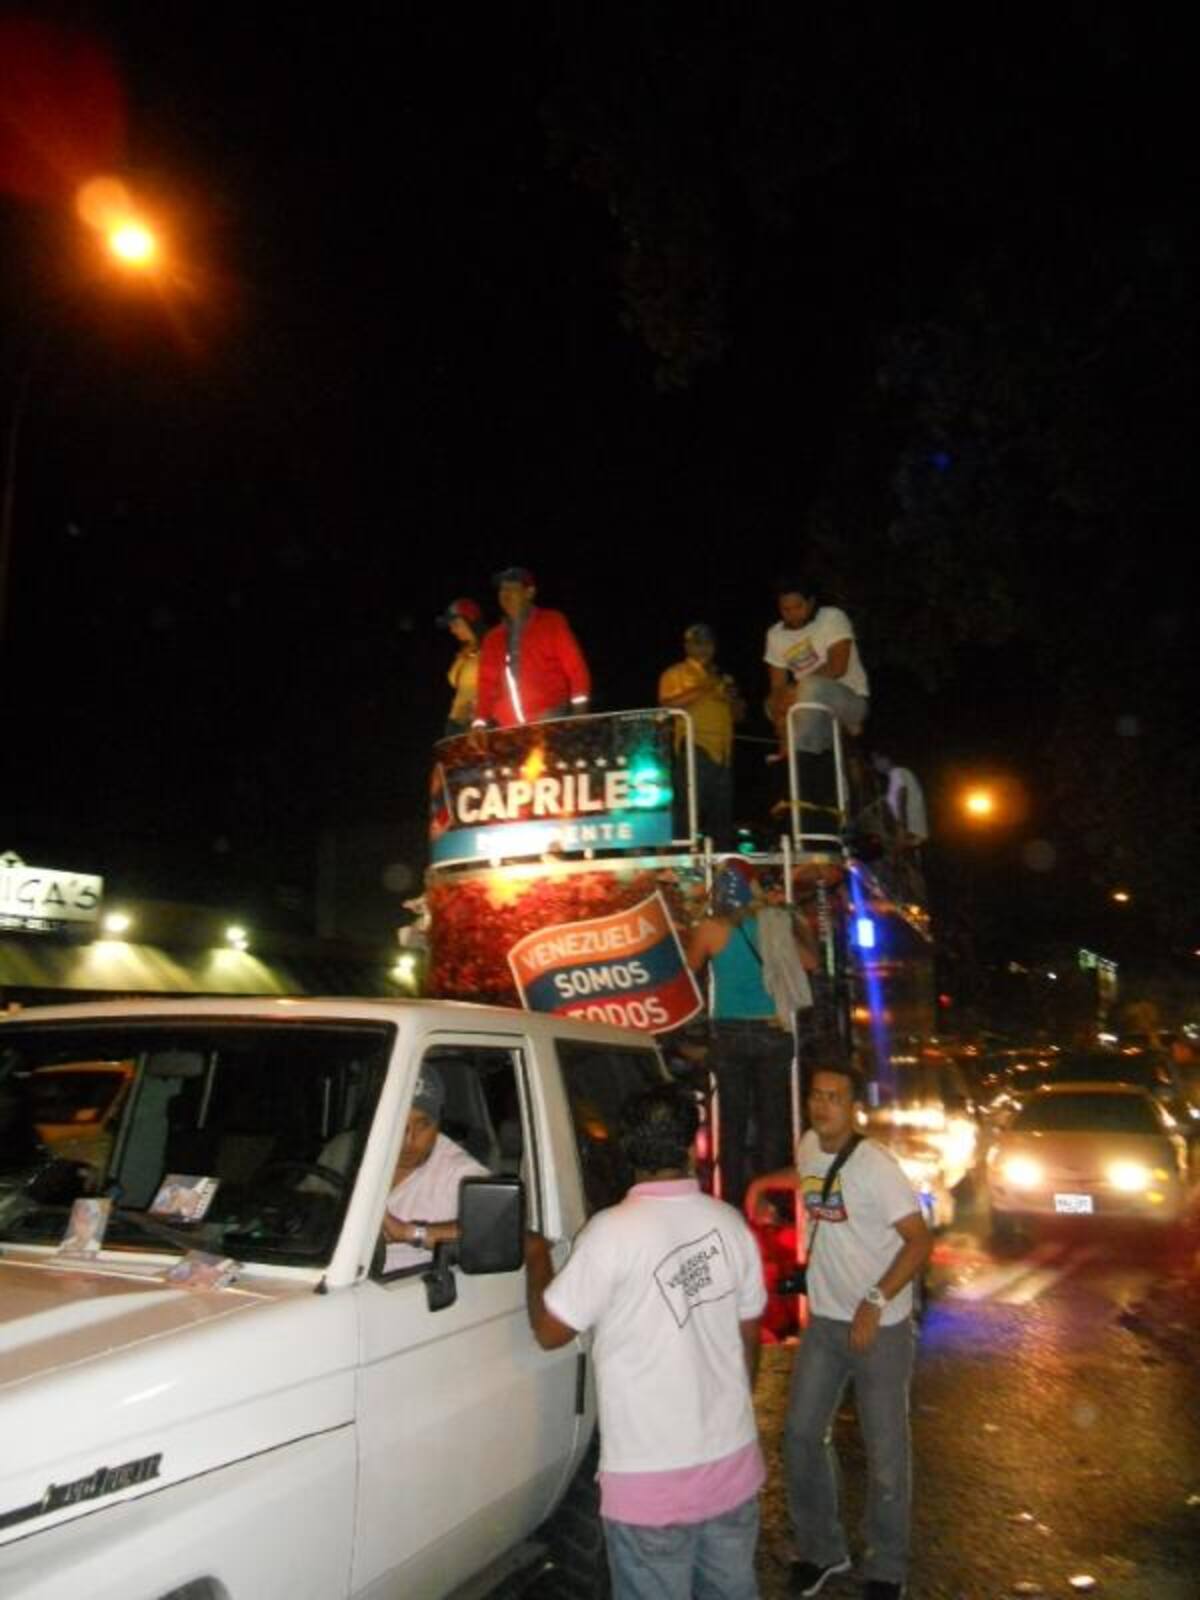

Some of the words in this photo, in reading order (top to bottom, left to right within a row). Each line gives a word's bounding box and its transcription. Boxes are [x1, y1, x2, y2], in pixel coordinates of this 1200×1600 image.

[457, 767, 664, 823] CAPRILES
[520, 916, 657, 970] VENEZUELA
[553, 961, 651, 999] SOMOS
